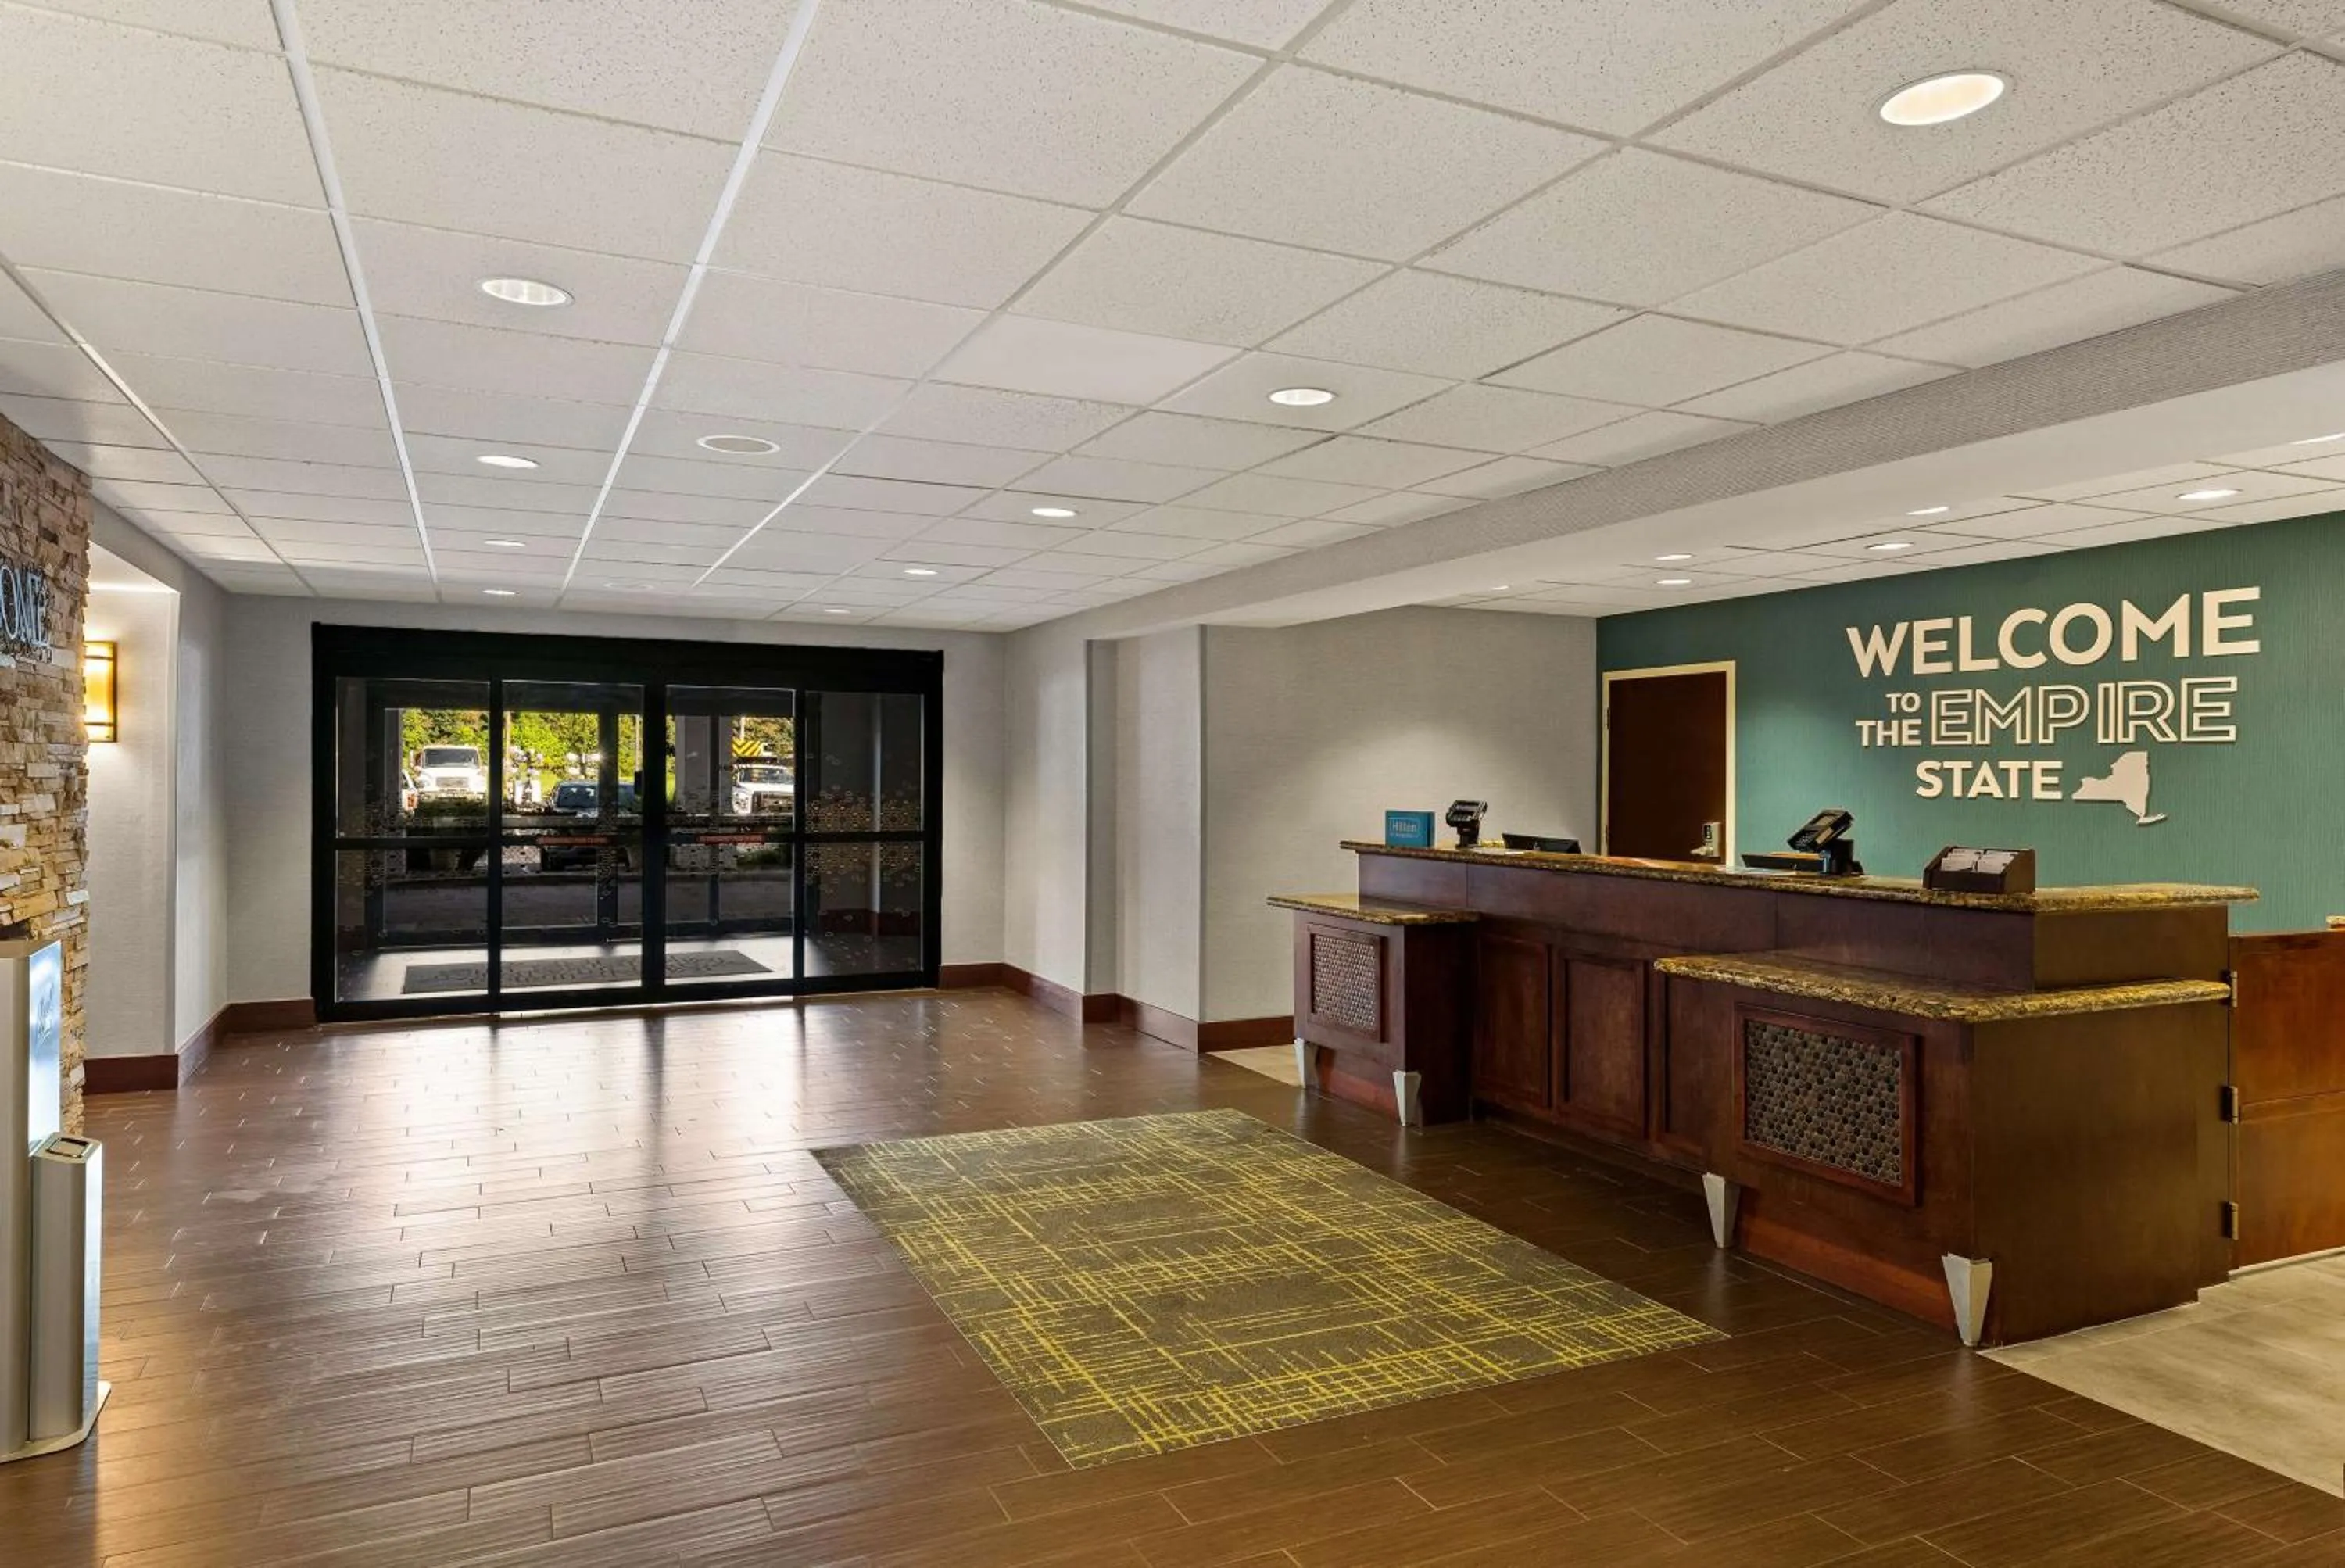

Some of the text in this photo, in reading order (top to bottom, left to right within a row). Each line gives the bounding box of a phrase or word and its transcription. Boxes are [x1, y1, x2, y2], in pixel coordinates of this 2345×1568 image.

[1846, 586, 2261, 678] WELCOME
[1855, 676, 2239, 747] THE EMPIRE
[1885, 692, 1921, 713] TO
[1915, 761, 2064, 800] STATE
